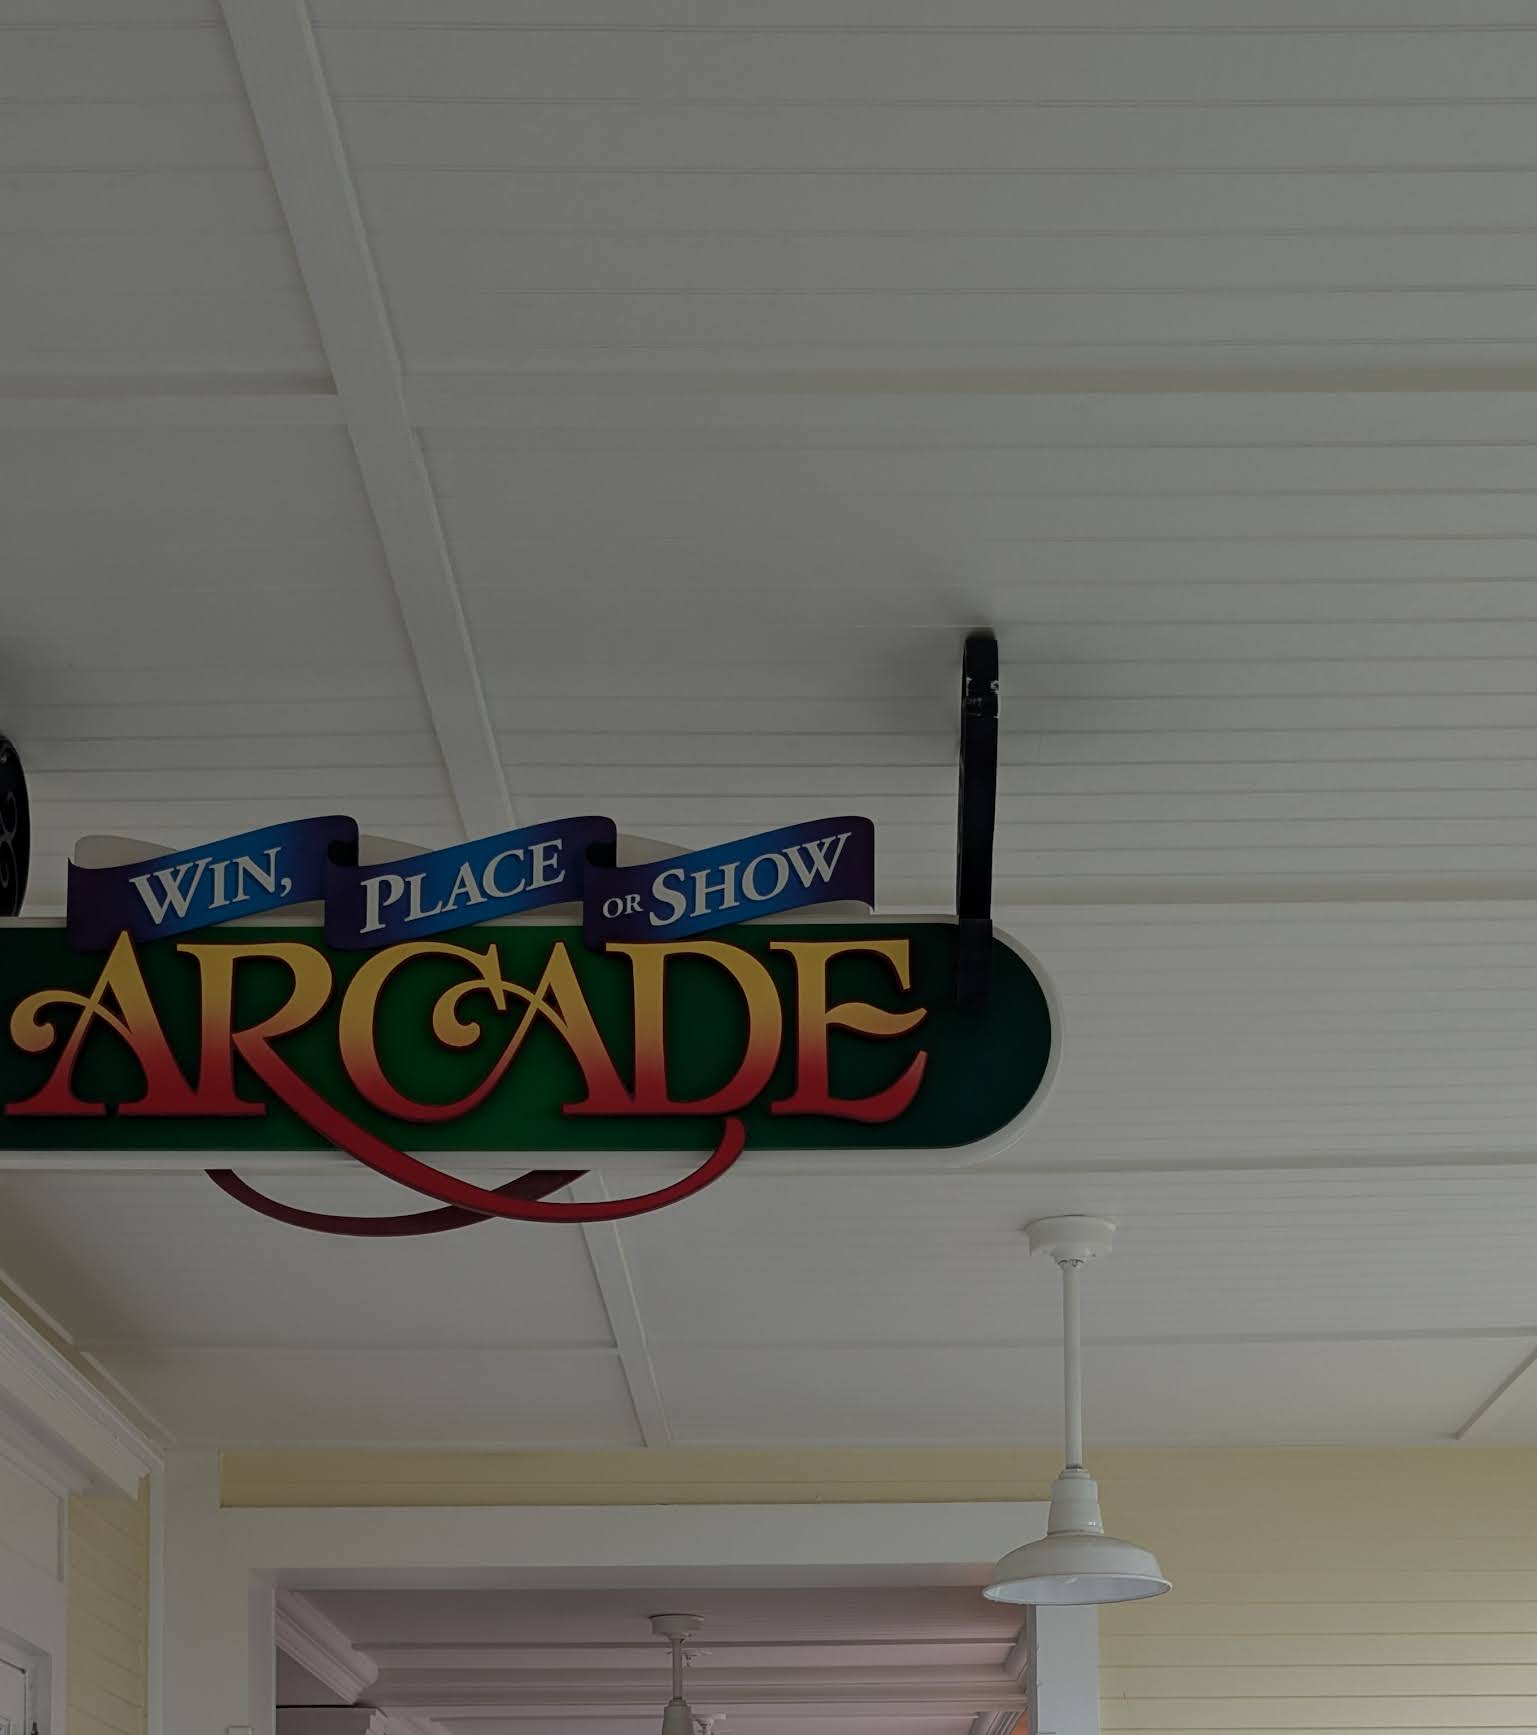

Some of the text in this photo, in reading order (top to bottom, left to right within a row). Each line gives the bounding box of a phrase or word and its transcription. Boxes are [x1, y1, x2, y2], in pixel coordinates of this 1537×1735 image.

[128, 846, 293, 925] WIN,
[359, 838, 566, 934] PLACE
[649, 832, 852, 926] SHOW
[2, 928, 929, 1222] ARCADE
